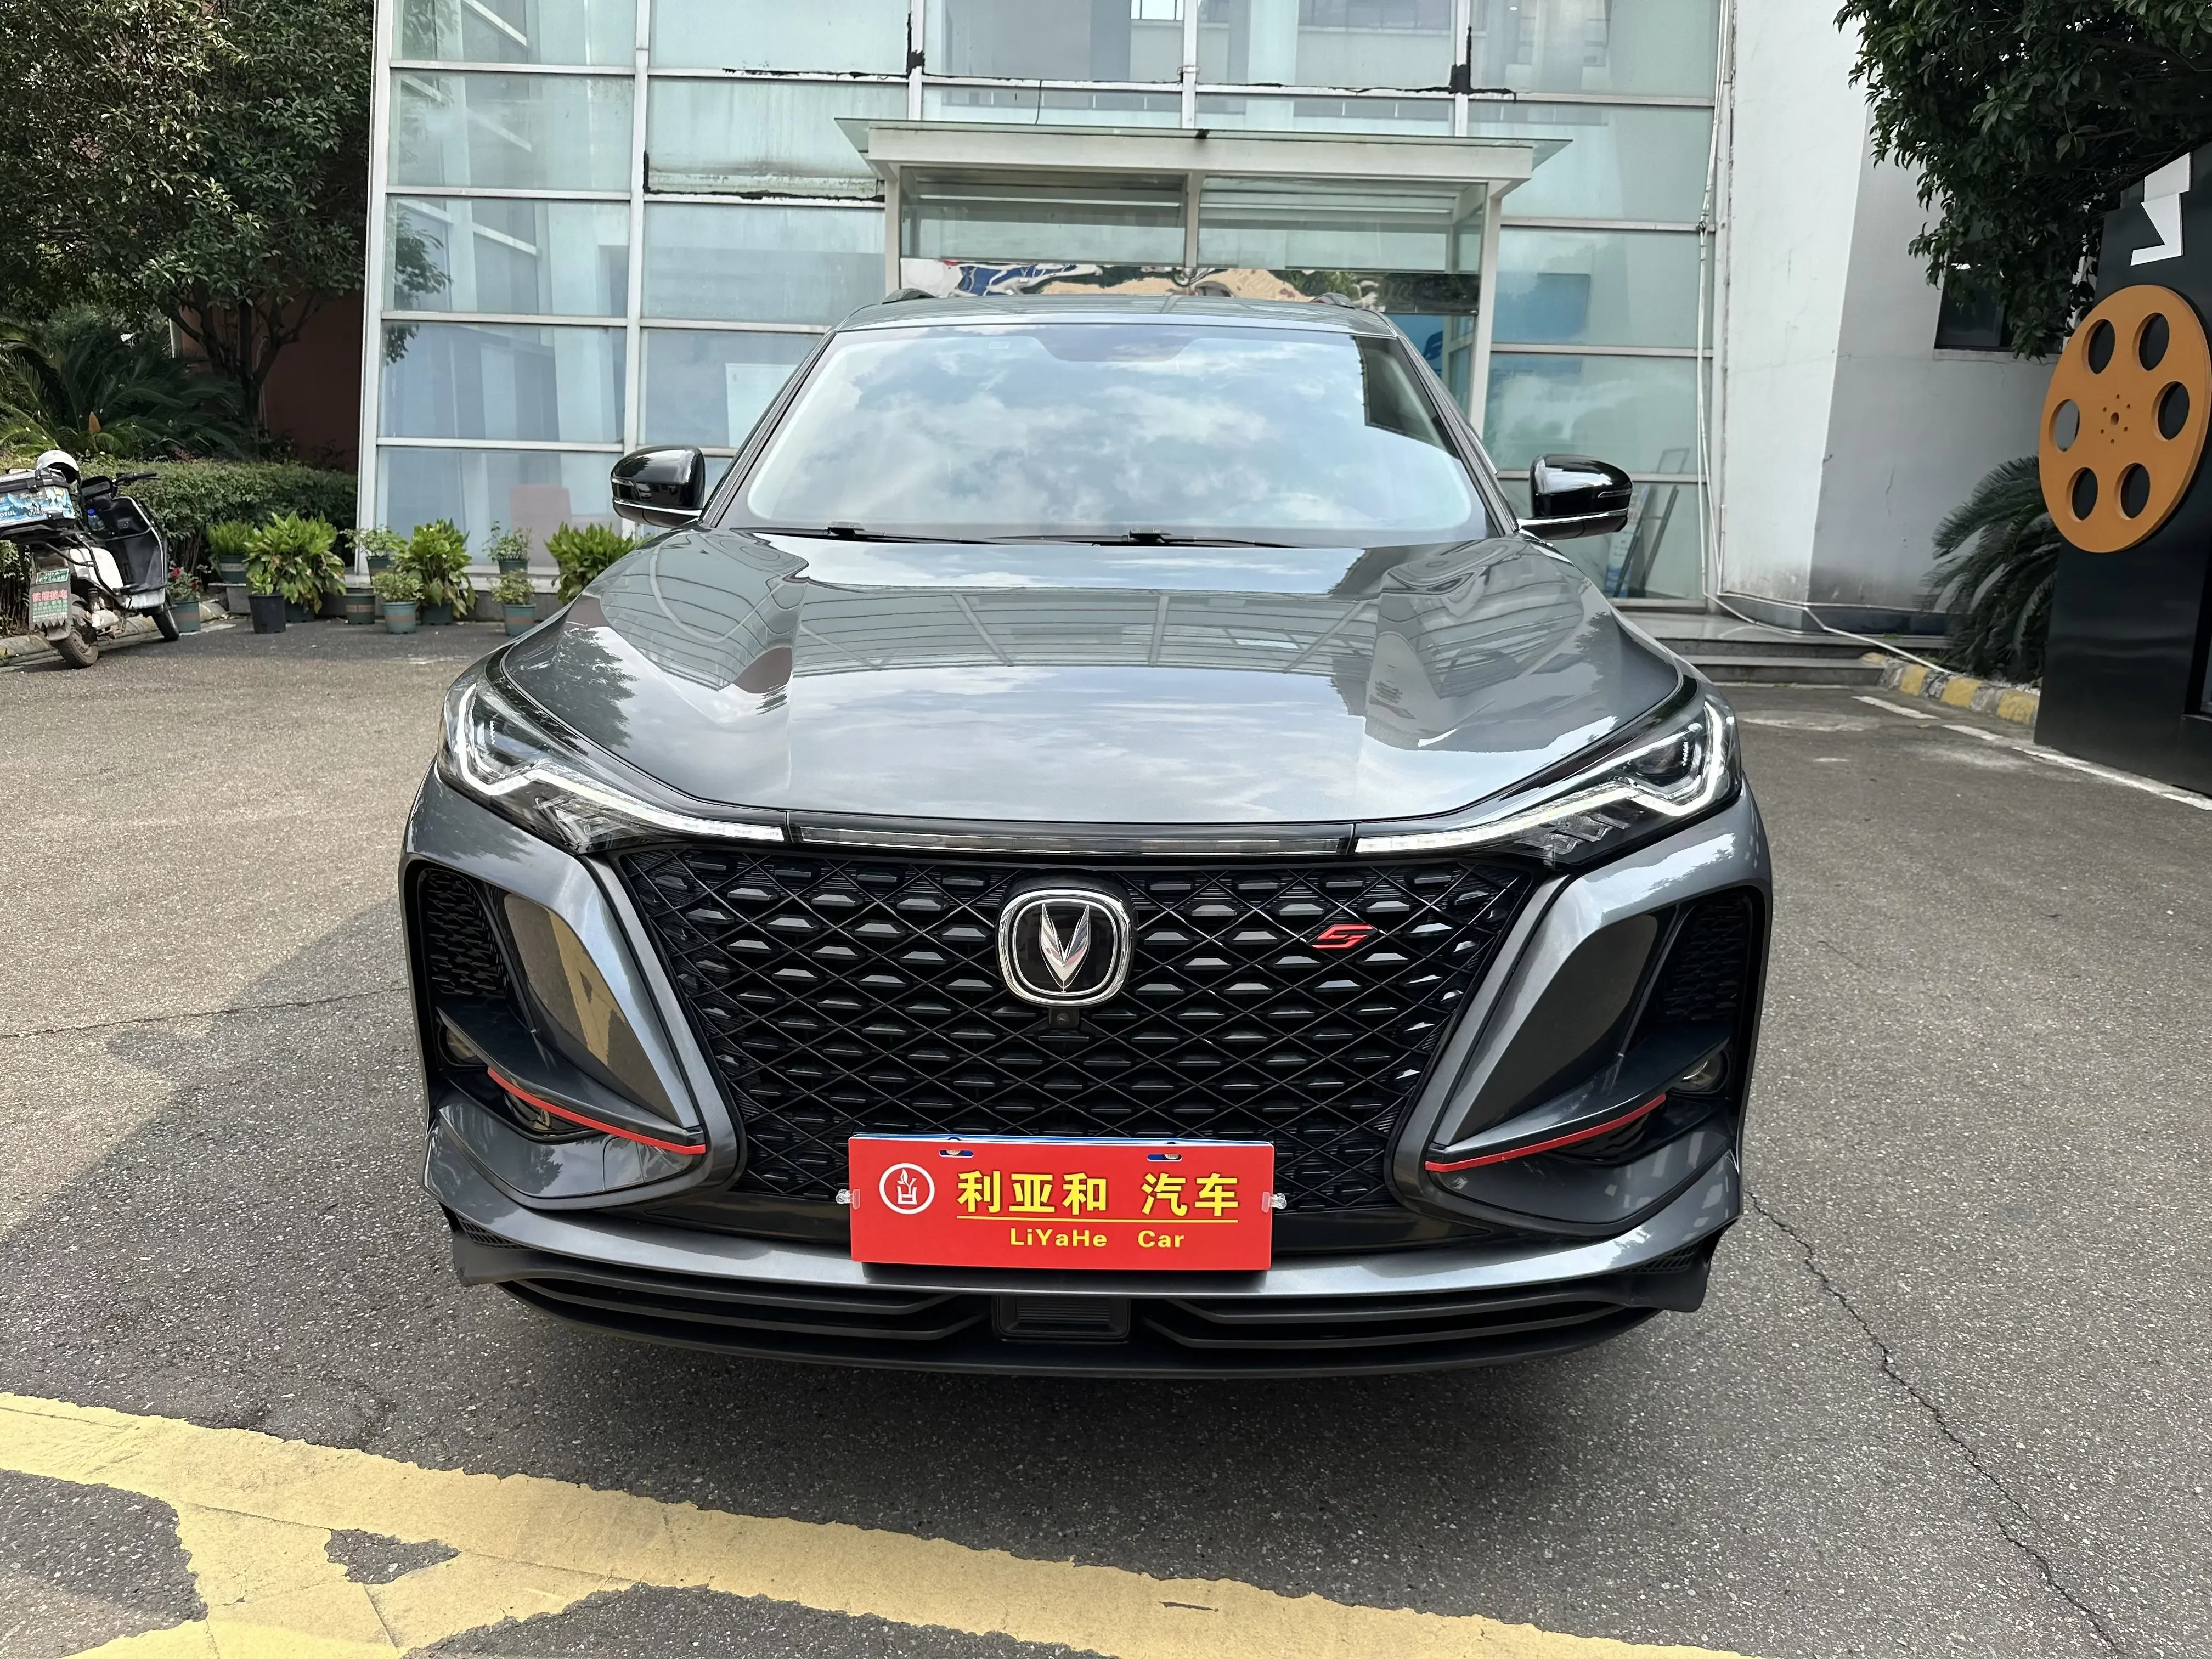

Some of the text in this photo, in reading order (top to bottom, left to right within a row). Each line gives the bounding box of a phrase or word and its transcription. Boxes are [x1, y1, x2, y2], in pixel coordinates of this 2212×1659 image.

[957, 1170, 1238, 1216] 利亚和 汽车
[1011, 1228, 1184, 1248] LiYaHe Car
